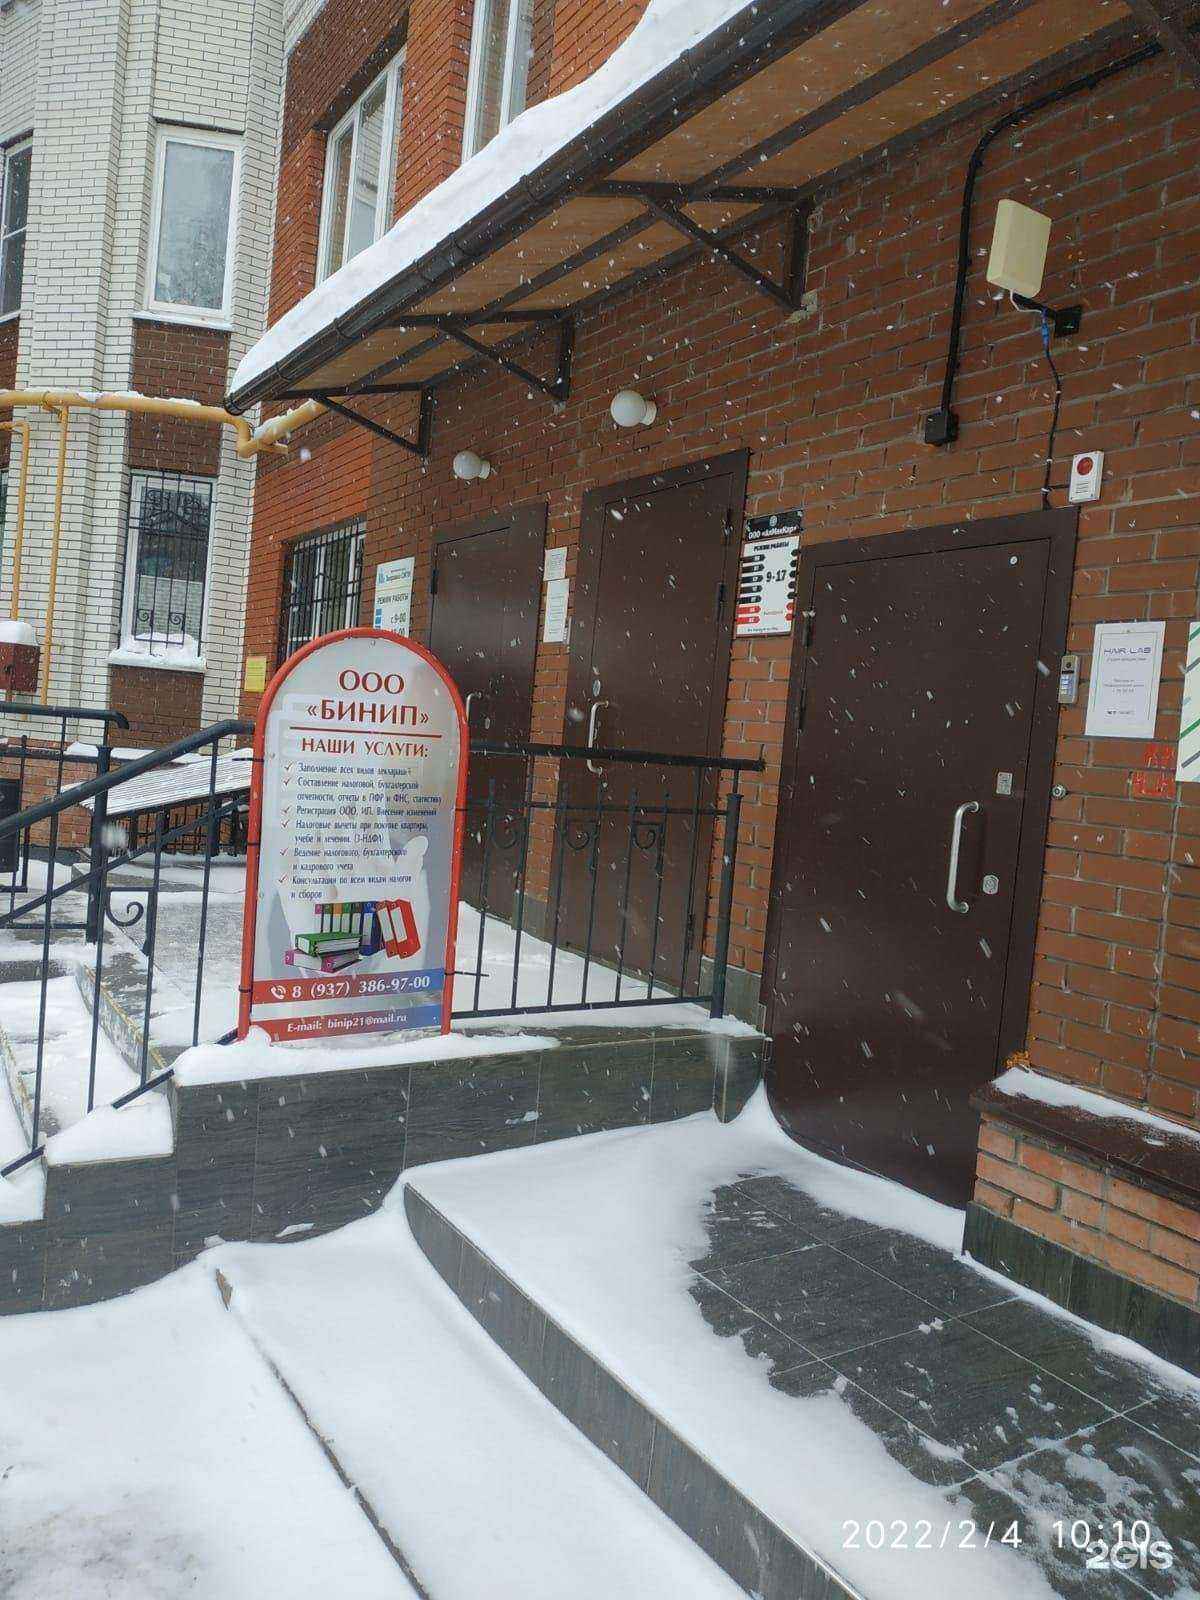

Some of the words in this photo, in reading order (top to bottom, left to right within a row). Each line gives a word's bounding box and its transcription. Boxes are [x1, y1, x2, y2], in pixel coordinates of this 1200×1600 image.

[338, 669, 405, 694] ООО
[307, 699, 429, 726] «БИНИП»
[301, 738, 355, 755] НАШИ
[364, 741, 429, 757] УСЛУГИ:
[298, 762, 338, 773] Заполнение
[297, 776, 339, 787] Составление
[338, 794, 360, 802] отчеты
[296, 805, 336, 817] Регистрация
[295, 819, 331, 829] Налоговые
[294, 833, 314, 845] учебе
[293, 847, 321, 857] Ведение
[300, 863, 334, 873] кадрового
[336, 864, 354, 873] учета
[298, 888, 322, 901] сборов
[292, 985, 302, 998] 8
[310, 981, 350, 999] (937)
[358, 975, 430, 994] 386-97-00
[287, 1021, 322, 1033] E-mail:
[328, 1014, 407, 1030] binip21@mail.ru
